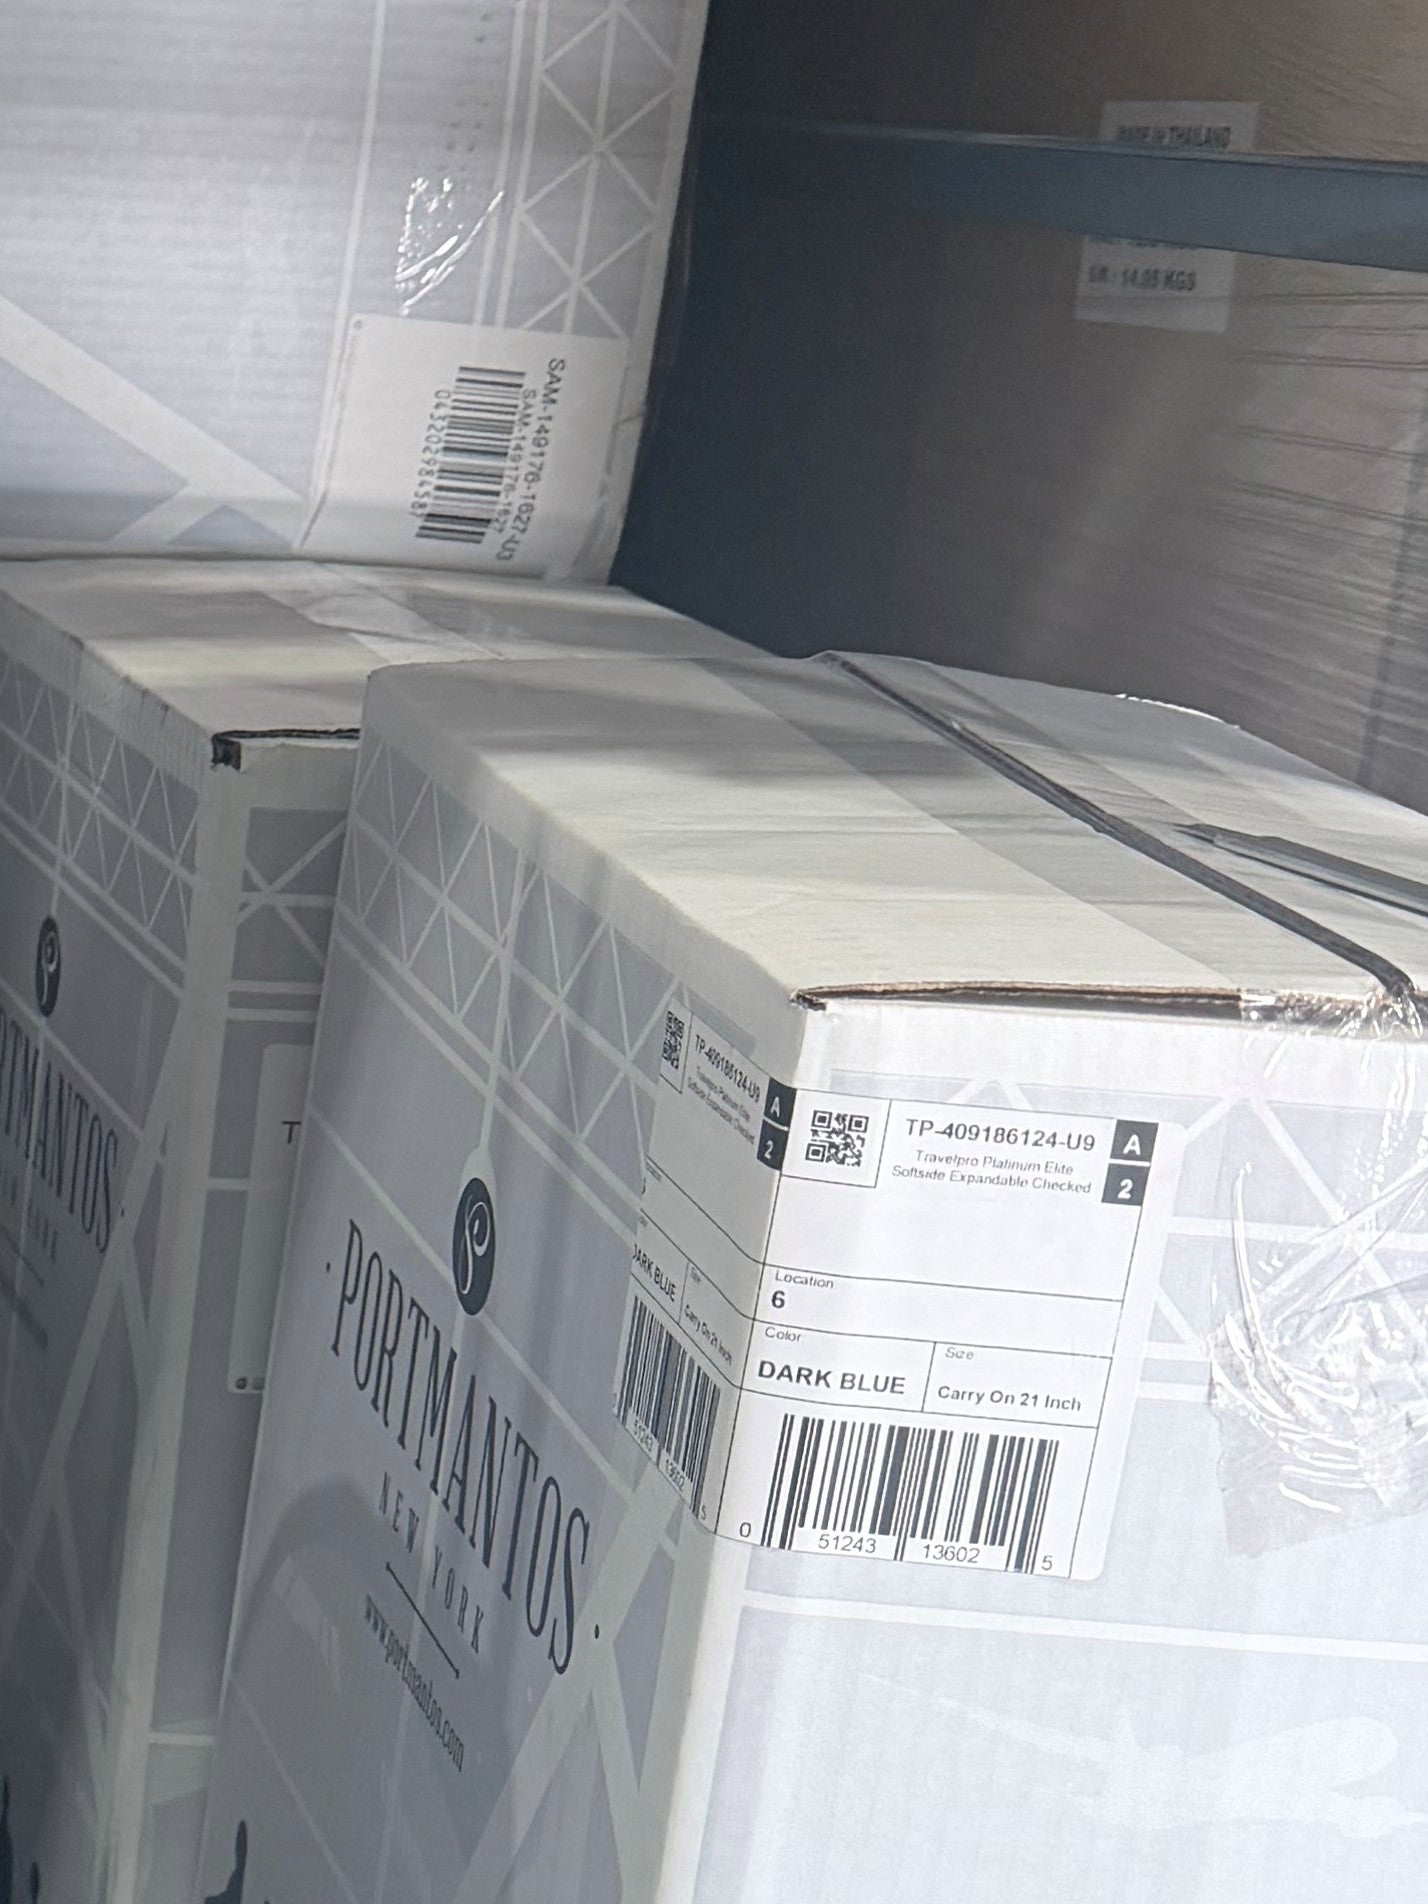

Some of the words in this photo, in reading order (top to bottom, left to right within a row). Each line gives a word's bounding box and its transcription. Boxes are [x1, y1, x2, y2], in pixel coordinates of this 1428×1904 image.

[770, 1102, 781, 1117] A
[906, 1118, 1096, 1153] TP-409186124-U9
[1123, 1134, 1142, 1155] A
[764, 1140, 773, 1159] 2
[915, 1148, 977, 1171] Travelpro
[982, 1154, 1040, 1174] Platinum
[892, 1164, 945, 1182] Softside
[949, 1169, 1028, 1191] Expandable
[1032, 1176, 1092, 1195] Checked
[1118, 1178, 1134, 1199] 2
[653, 1268, 676, 1302] BLUE
[775, 1270, 834, 1290] Location
[771, 1290, 786, 1310] 6
[765, 1326, 802, 1344] Color
[758, 1359, 833, 1390] DARK
[839, 1371, 906, 1395] BLUE
[938, 1385, 986, 1409] Carry
[989, 1388, 1015, 1405] On
[1020, 1392, 1039, 1408] 21
[1044, 1393, 1082, 1413] Inch
[330, 1218, 589, 1675] PORTMANTOS
[739, 1521, 751, 1539] 0
[818, 1533, 877, 1555] 51243
[922, 1543, 982, 1565] 13602
[379, 1472, 421, 1554] NEW
[429, 1542, 485, 1655] YORK
[1042, 1554, 1053, 1572] 5
